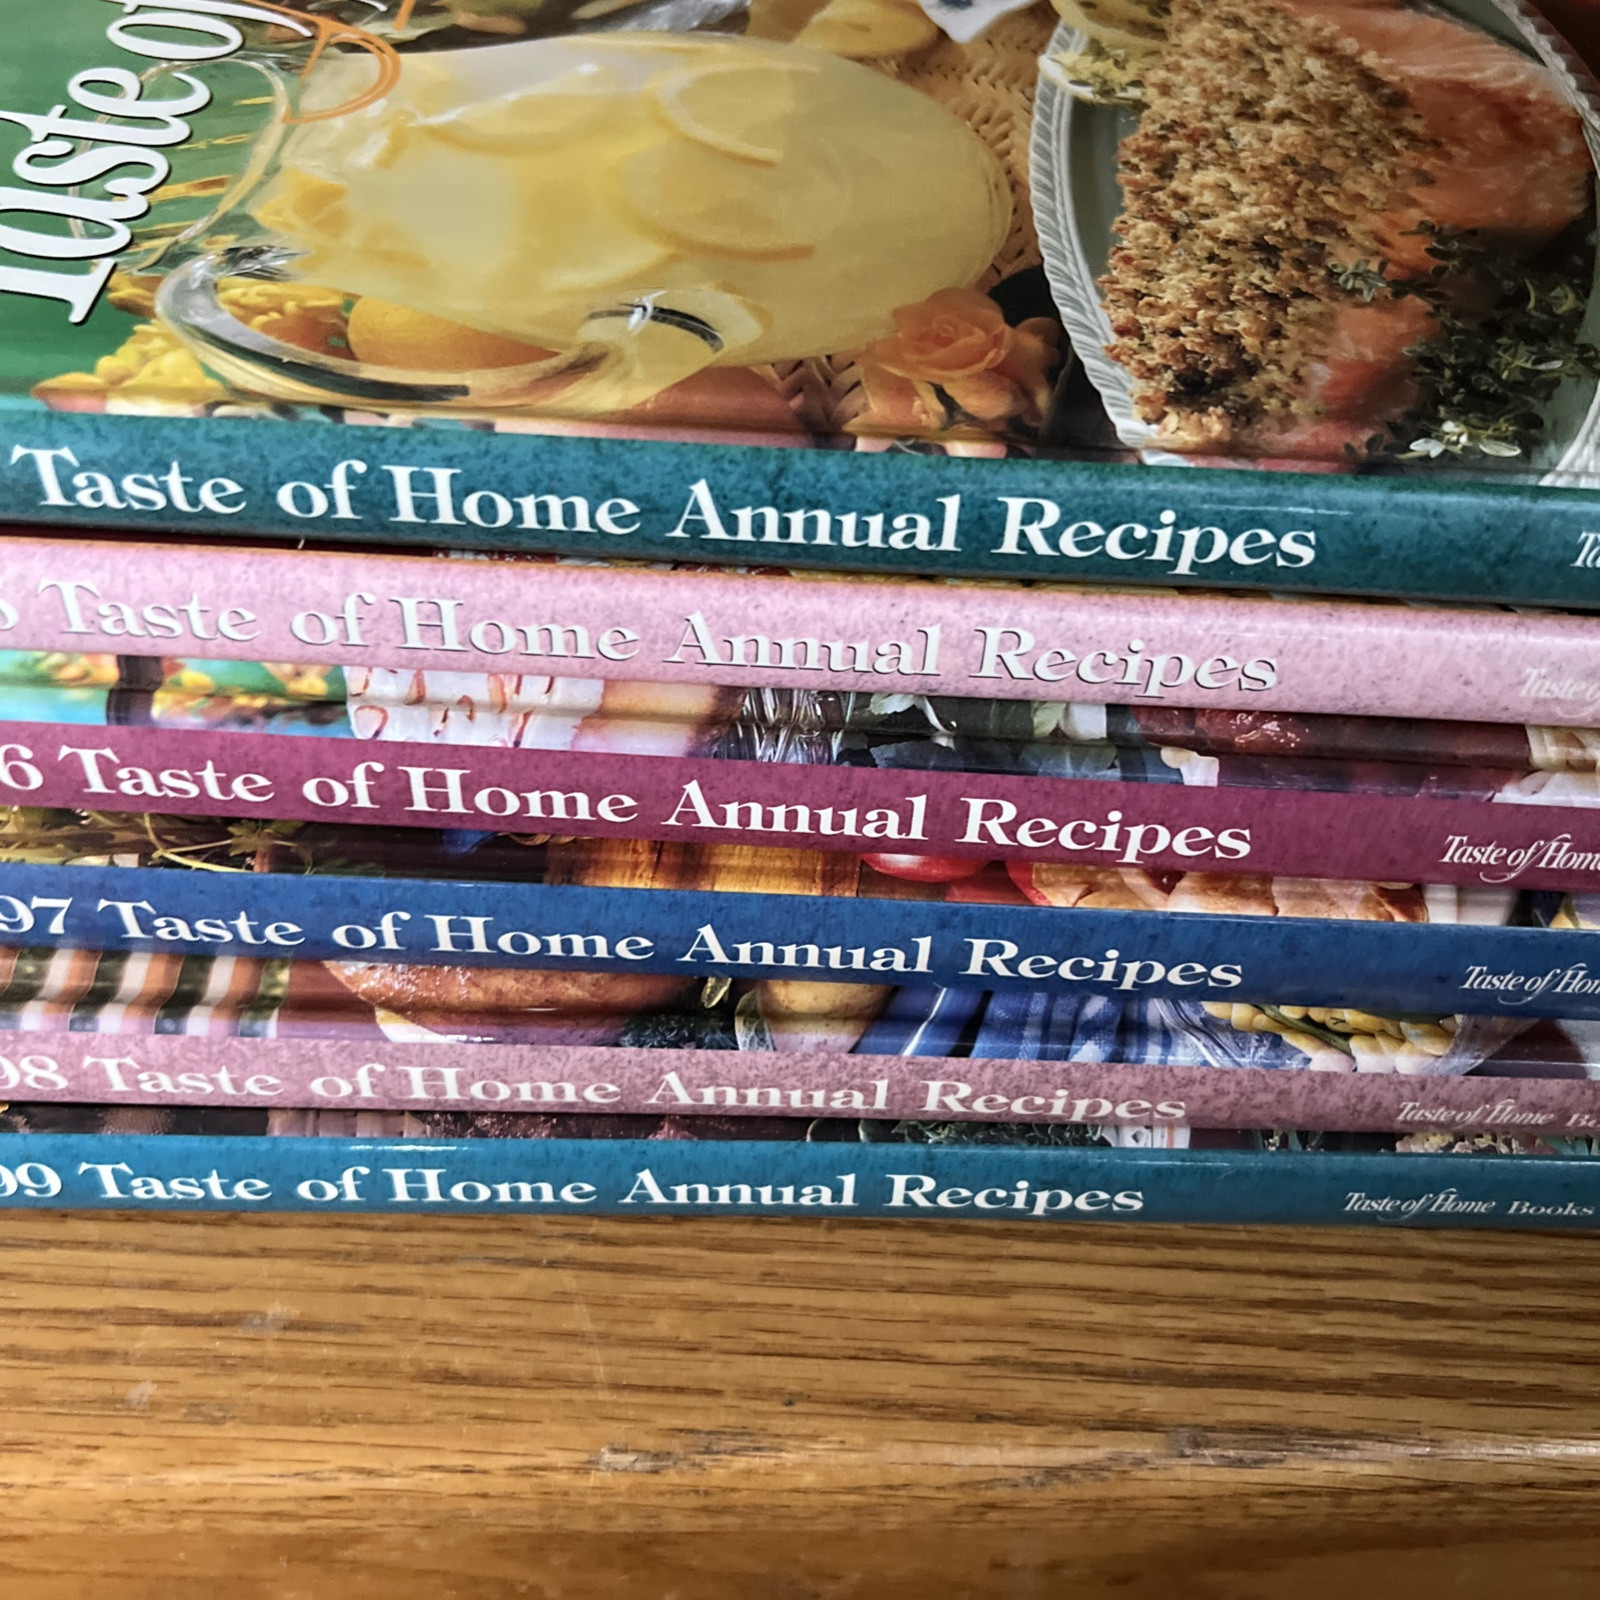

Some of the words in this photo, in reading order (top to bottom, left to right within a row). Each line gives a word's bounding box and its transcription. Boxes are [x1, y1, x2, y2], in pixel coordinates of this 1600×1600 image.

[11, 444, 246, 513] Taste
[277, 460, 367, 519] of
[382, 465, 640, 534] Home
[666, 479, 960, 552] Annual
[991, 497, 1315, 574] Recipes
[38, 580, 261, 642] Taste
[291, 593, 376, 646] of
[389, 596, 641, 661] Home
[663, 610, 943, 678] Annual
[970, 626, 1279, 698] Recipes
[58, 745, 274, 801] Taste
[303, 762, 384, 808] of
[398, 766, 637, 822] Home
[661, 780, 928, 839] Annual
[955, 798, 1250, 863] Recipes
[1439, 835, 1507, 865] Taste
[1502, 840, 1545, 880] of
[1535, 833, 1600, 871] Hom
[97, 899, 305, 945] Taste
[333, 912, 411, 949] of
[425, 915, 653, 959] Home
[677, 924, 932, 972] Annual
[962, 939, 1241, 989] Recipes
[1459, 966, 1524, 990] Taste
[1521, 969, 1561, 1003] of
[82, 1055, 284, 1095] Taste
[310, 1063, 385, 1097] of
[397, 1066, 620, 1102] Home
[646, 1071, 888, 1109] Annual
[919, 1077, 1185, 1121] Recipes
[1397, 1101, 1455, 1122] Taste
[1455, 1104, 1490, 1128] of
[1481, 1099, 1555, 1126] Home
[79, 1162, 271, 1200] Taste
[297, 1167, 370, 1201] of
[383, 1169, 596, 1203] Home
[619, 1169, 856, 1205] Annual
[884, 1175, 1143, 1215] Recipes
[1343, 1192, 1402, 1212] Taste
[1399, 1193, 1433, 1220] of
[1428, 1188, 1496, 1214] Home
[1506, 1201, 1595, 1216] Books
